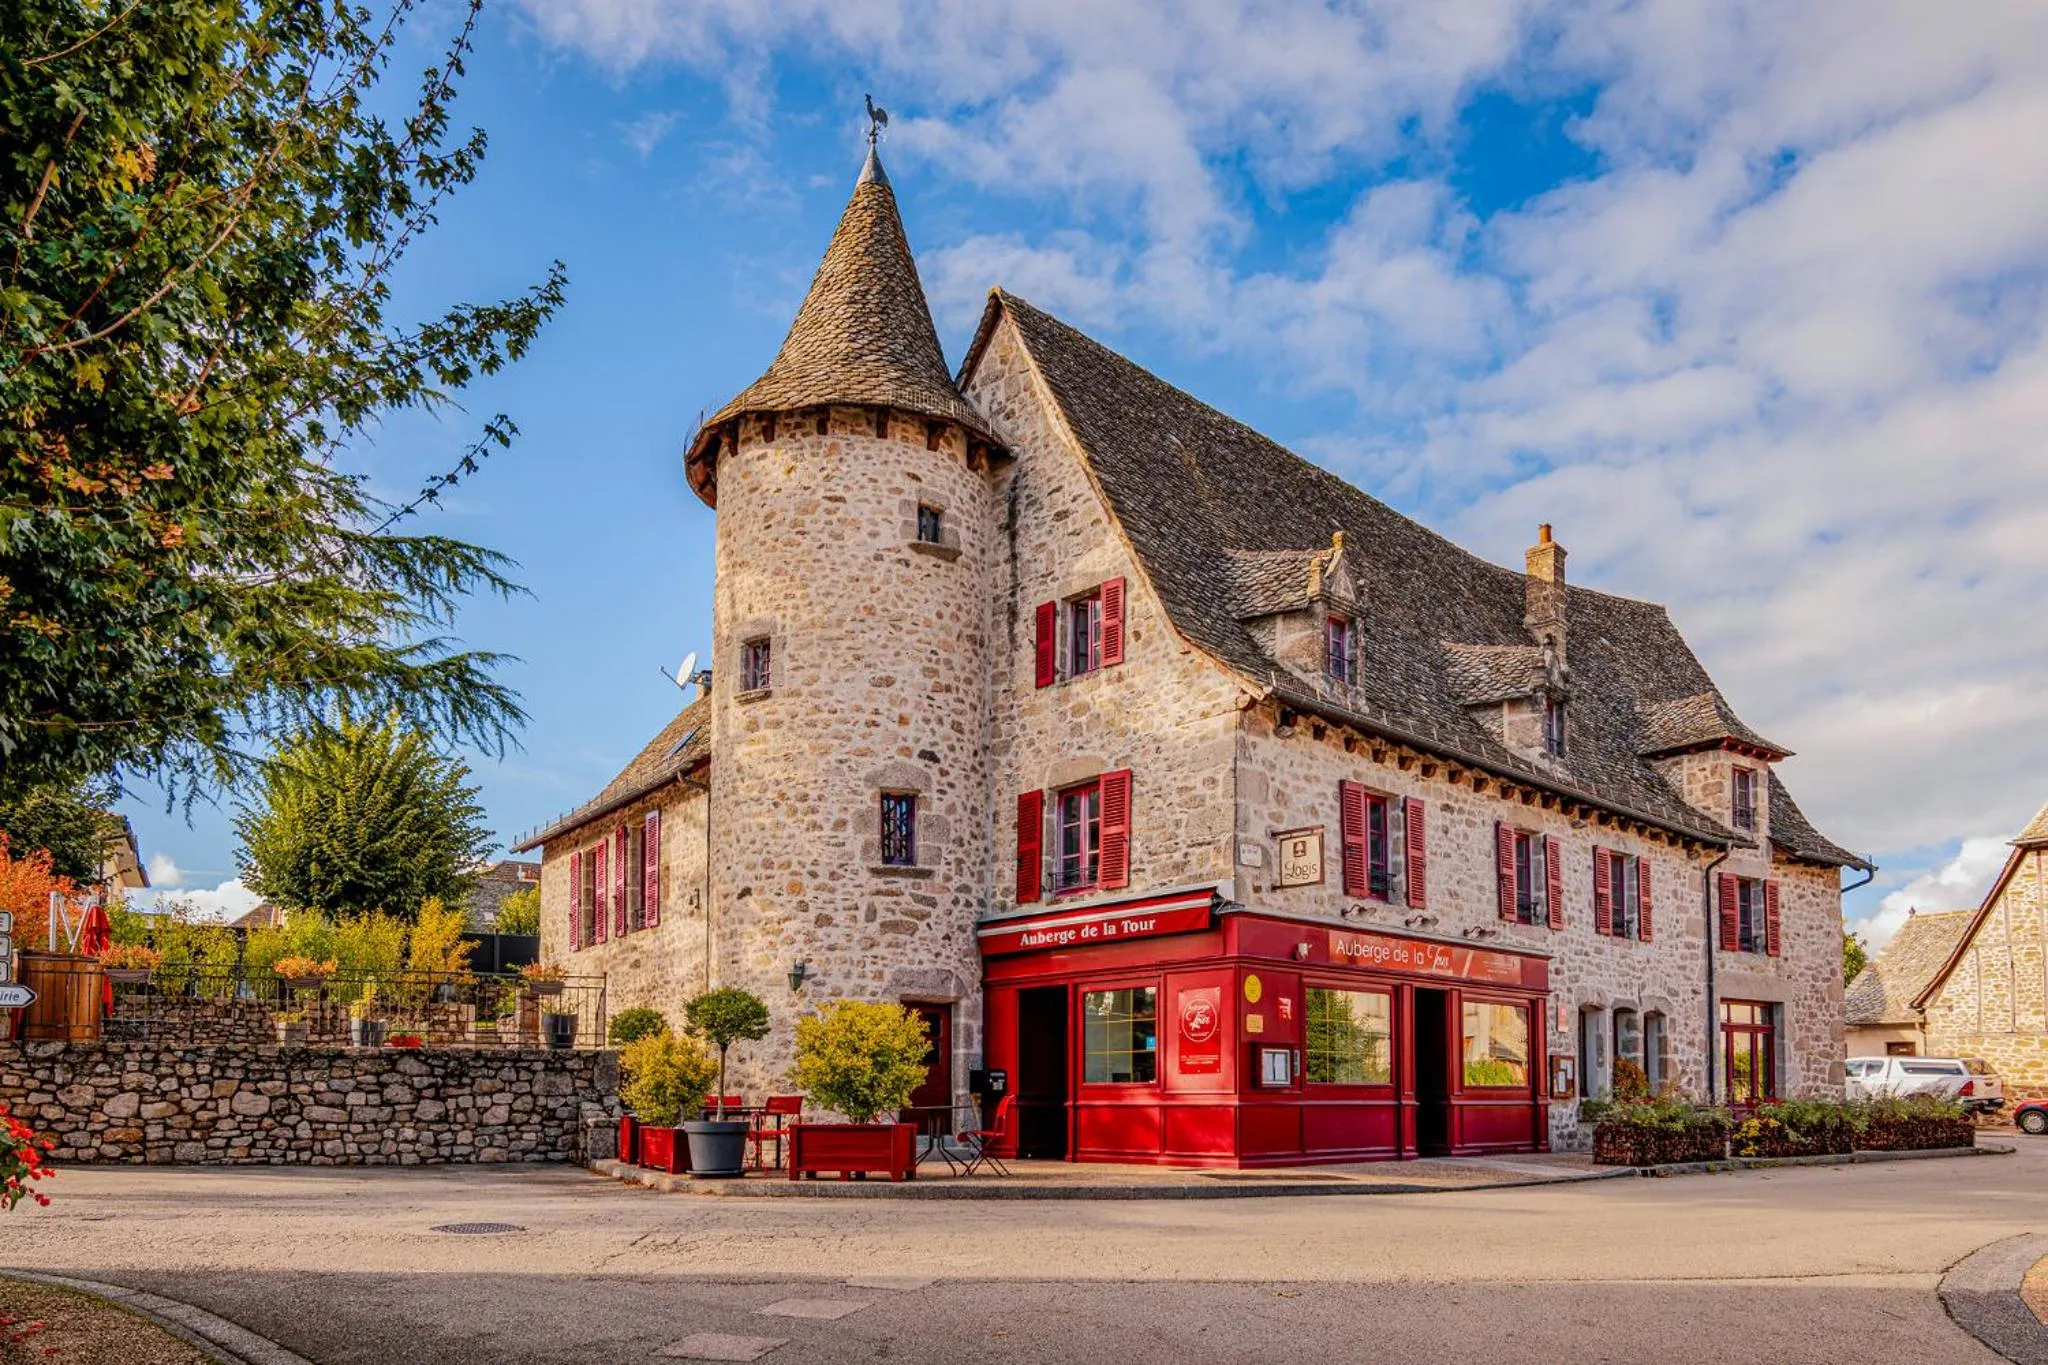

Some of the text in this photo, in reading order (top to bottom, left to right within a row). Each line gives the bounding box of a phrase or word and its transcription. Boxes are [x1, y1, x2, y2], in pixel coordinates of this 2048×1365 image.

[1020, 919, 1156, 946] Auberge de la Tour
[1336, 939, 1390, 963] Auberge
[1393, 946, 1409, 963] de
[1414, 947, 1424, 965] la
